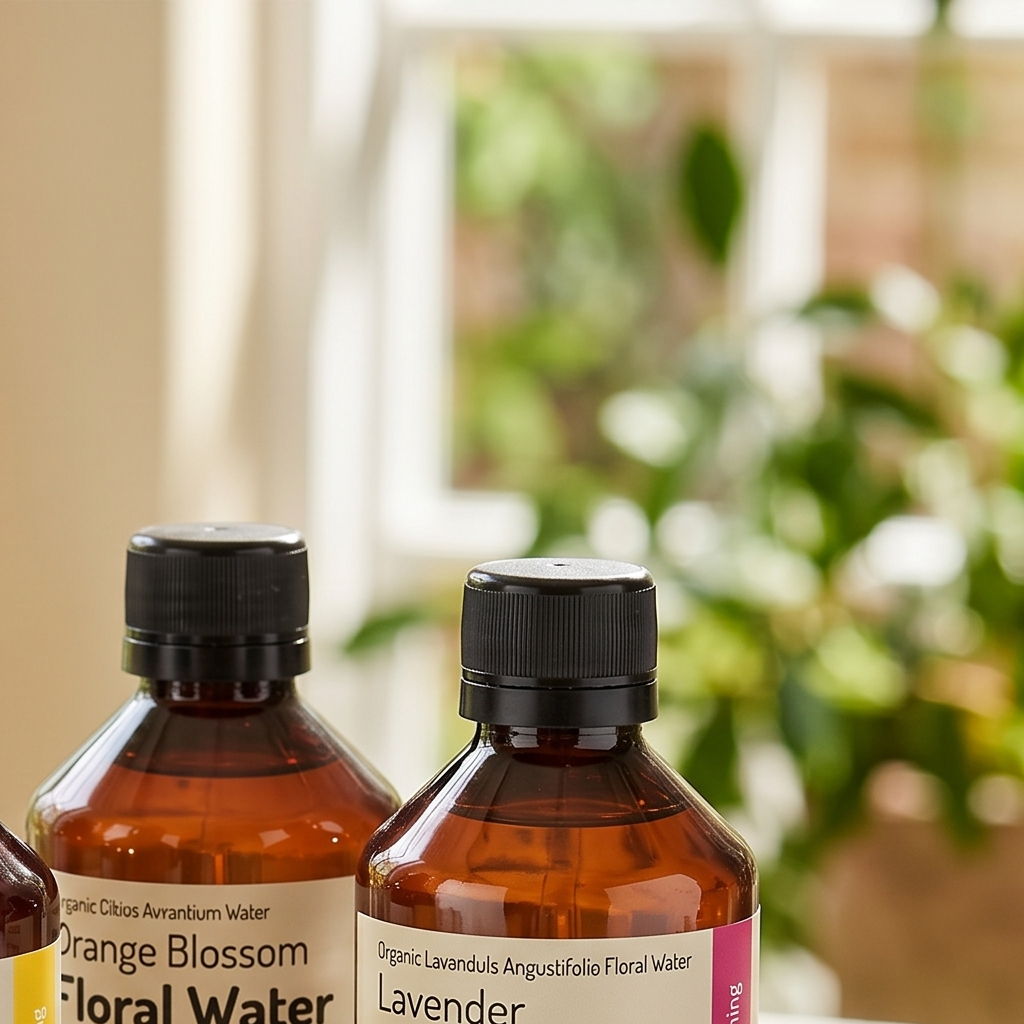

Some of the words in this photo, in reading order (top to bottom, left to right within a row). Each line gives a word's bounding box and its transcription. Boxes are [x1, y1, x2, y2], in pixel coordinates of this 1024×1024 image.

[62, 897, 97, 915] rganic
[226, 904, 270, 920] Water
[169, 934, 307, 969] Blossom
[379, 941, 421, 966] Organic
[606, 955, 647, 975] Floral
[651, 954, 692, 972] Water
